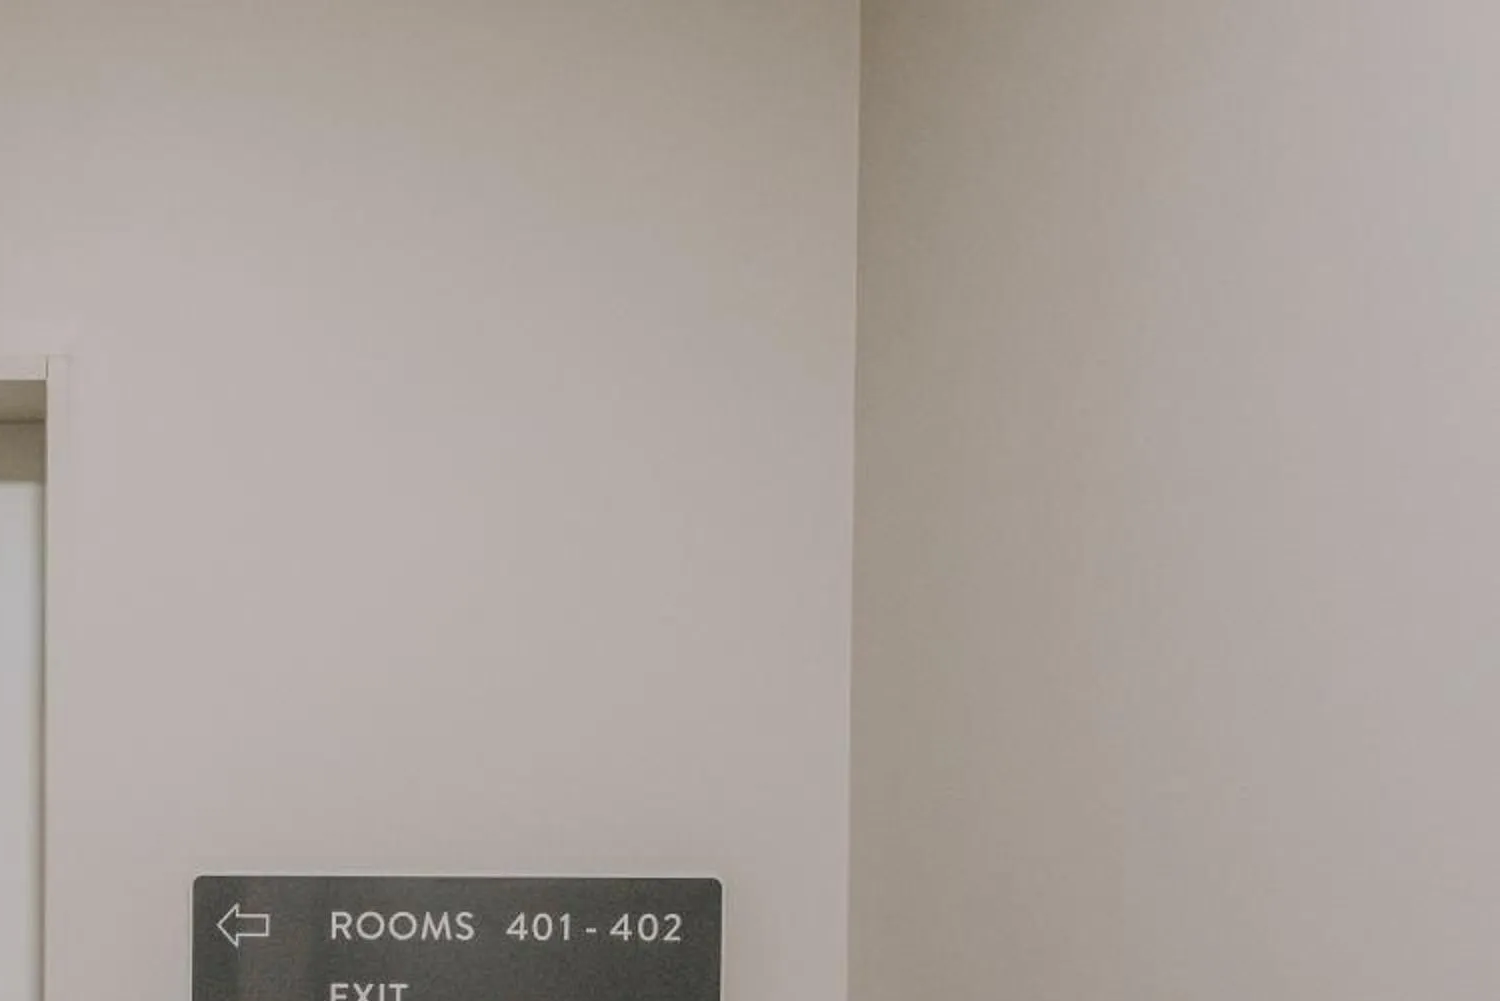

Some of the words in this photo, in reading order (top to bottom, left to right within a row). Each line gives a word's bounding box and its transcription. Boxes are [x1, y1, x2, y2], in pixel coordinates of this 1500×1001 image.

[329, 910, 476, 942] ROOMS
[504, 911, 572, 942] 401
[608, 912, 684, 942] 402
